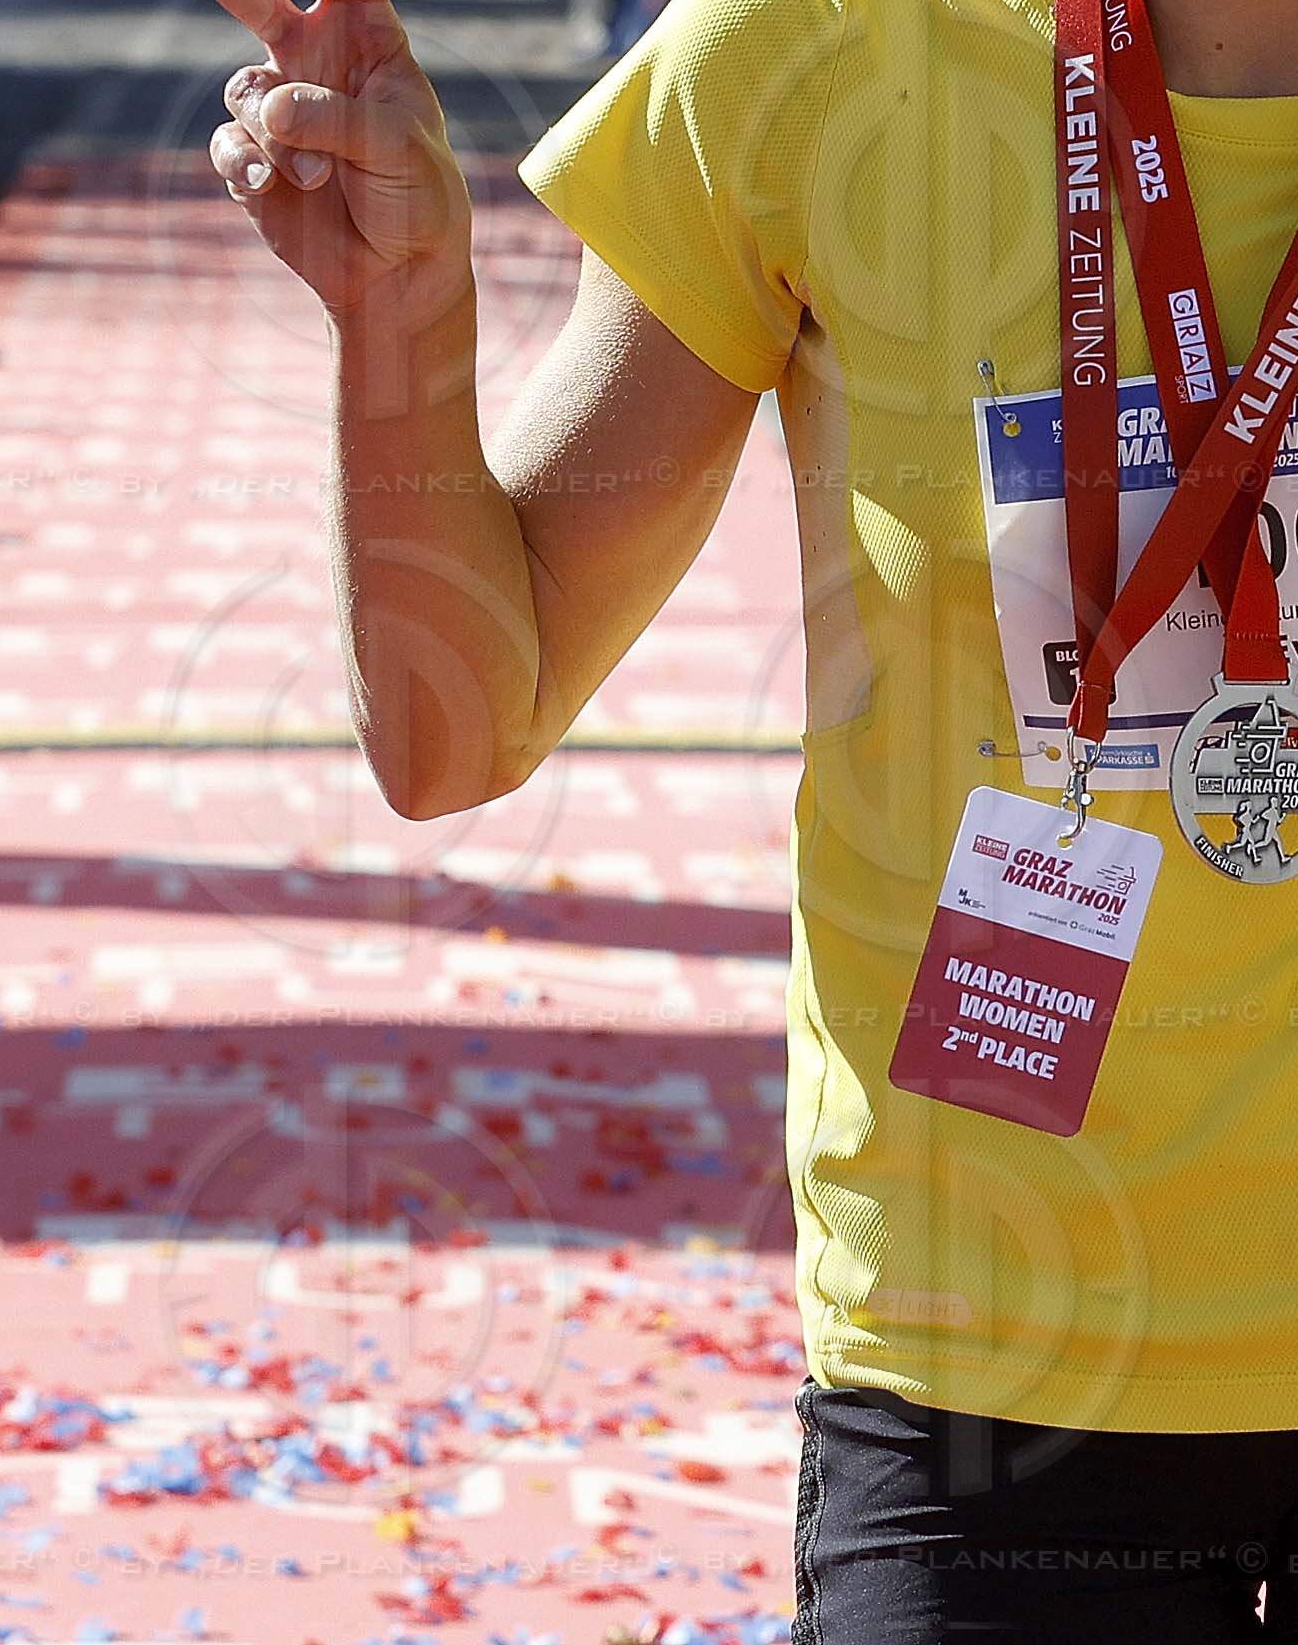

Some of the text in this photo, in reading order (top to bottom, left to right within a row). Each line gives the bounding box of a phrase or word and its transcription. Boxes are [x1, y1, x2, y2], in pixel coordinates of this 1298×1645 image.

[1132, 135, 1169, 203] 2025
[1065, 53, 1106, 387] KLEINE ZEITUNG
[1169, 290, 1216, 401] GRAZ
[1166, 610, 1226, 632] Klein
[1056, 650, 1079, 662] BLO
[1013, 848, 1073, 878] GRAZ
[1195, 836, 1244, 878] FINISHER
[1002, 864, 1128, 916] MARATHON
[1098, 912, 1121, 926] 2025
[944, 956, 1096, 1022] MARATHON
[959, 991, 1066, 1044] WOMEN
[942, 1026, 1060, 1080] 2nd PLACE
